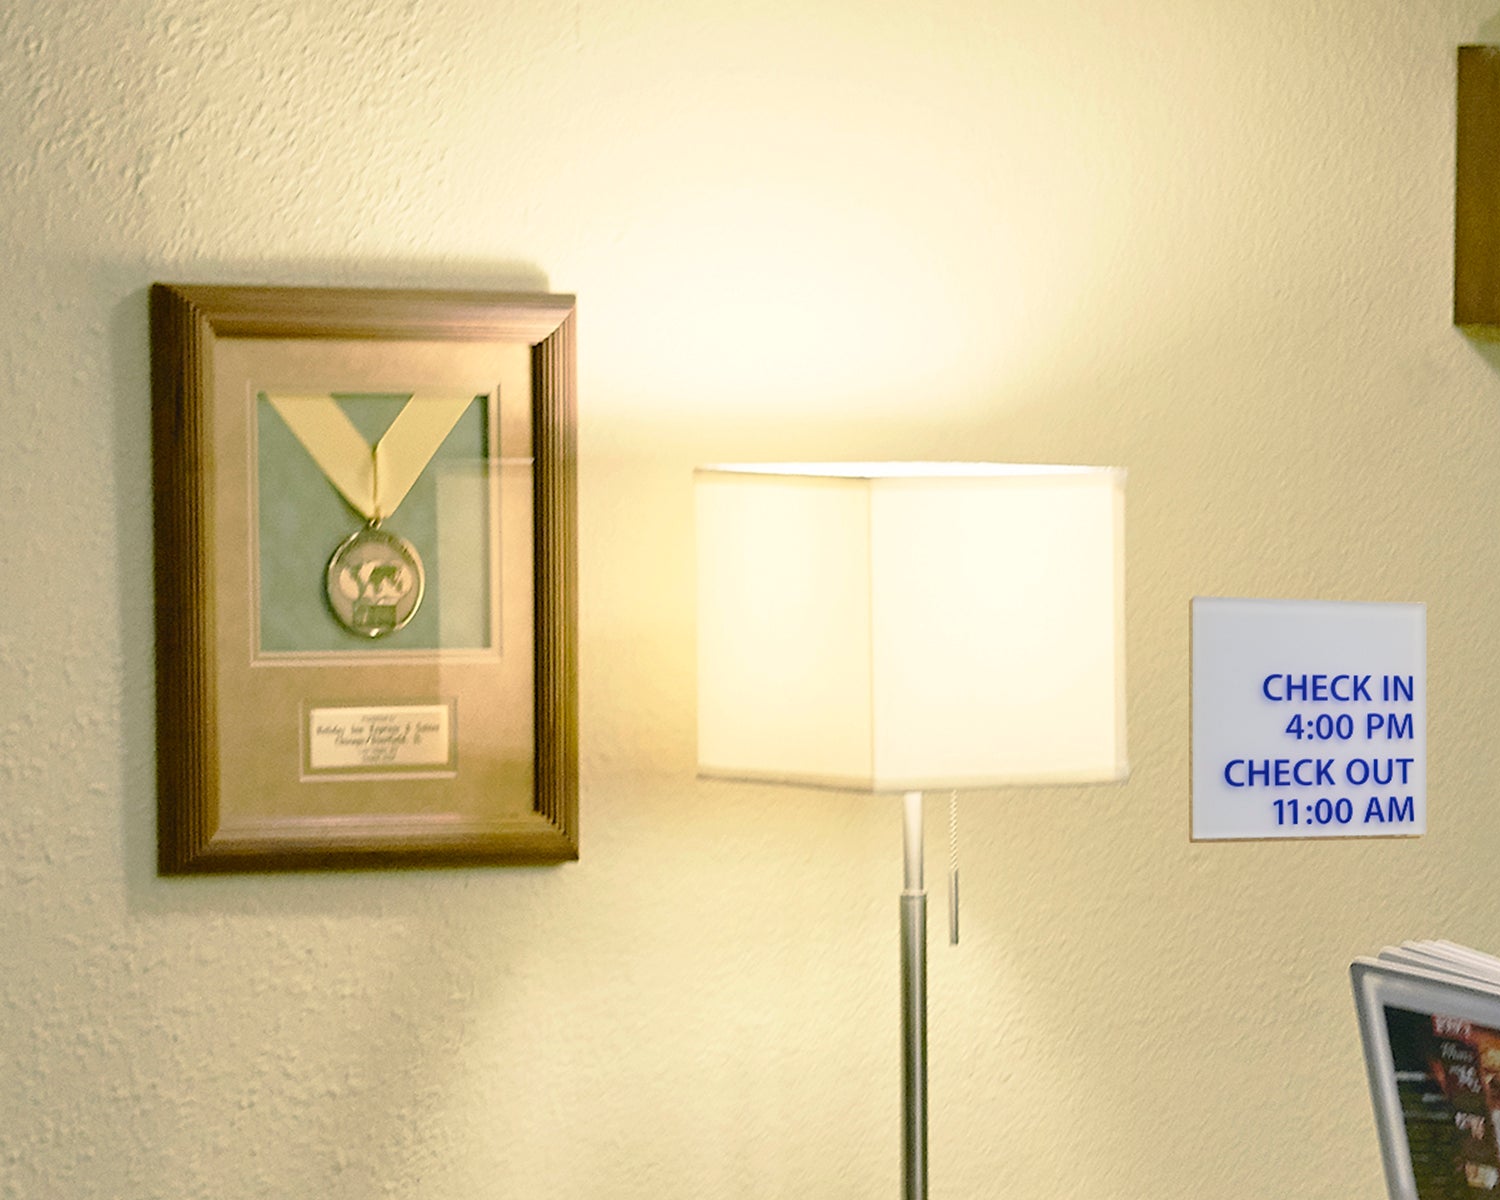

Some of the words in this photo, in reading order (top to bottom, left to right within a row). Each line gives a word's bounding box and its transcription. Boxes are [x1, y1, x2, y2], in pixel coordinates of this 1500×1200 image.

[1262, 673, 1372, 702] CHECK
[1382, 674, 1414, 702] IN
[1284, 713, 1355, 740] 4:00
[1366, 712, 1414, 740] PM
[1223, 758, 1336, 788] CHECK
[1345, 757, 1414, 786] OUT
[1272, 797, 1354, 826] 11:00
[1363, 795, 1415, 824] AM
